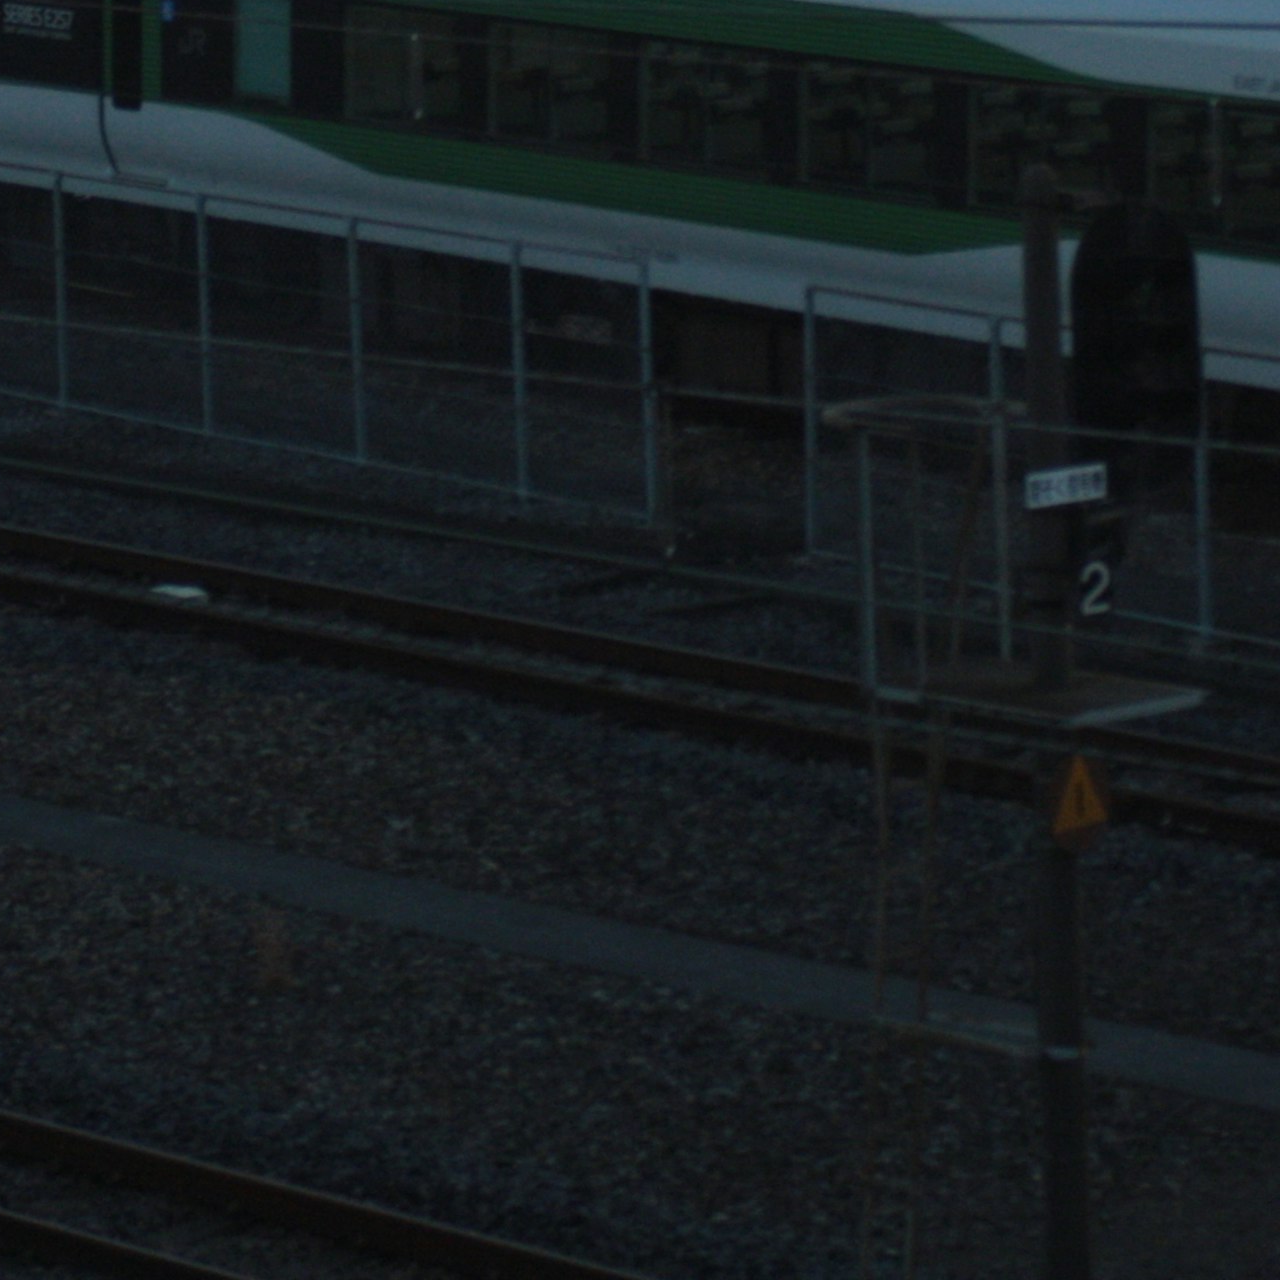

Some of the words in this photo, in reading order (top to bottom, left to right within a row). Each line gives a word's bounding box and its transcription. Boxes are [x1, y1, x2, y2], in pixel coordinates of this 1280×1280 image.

[2, 2, 43, 26] SERIES
[179, 26, 207, 56] JR
[1079, 560, 1112, 616] 2
